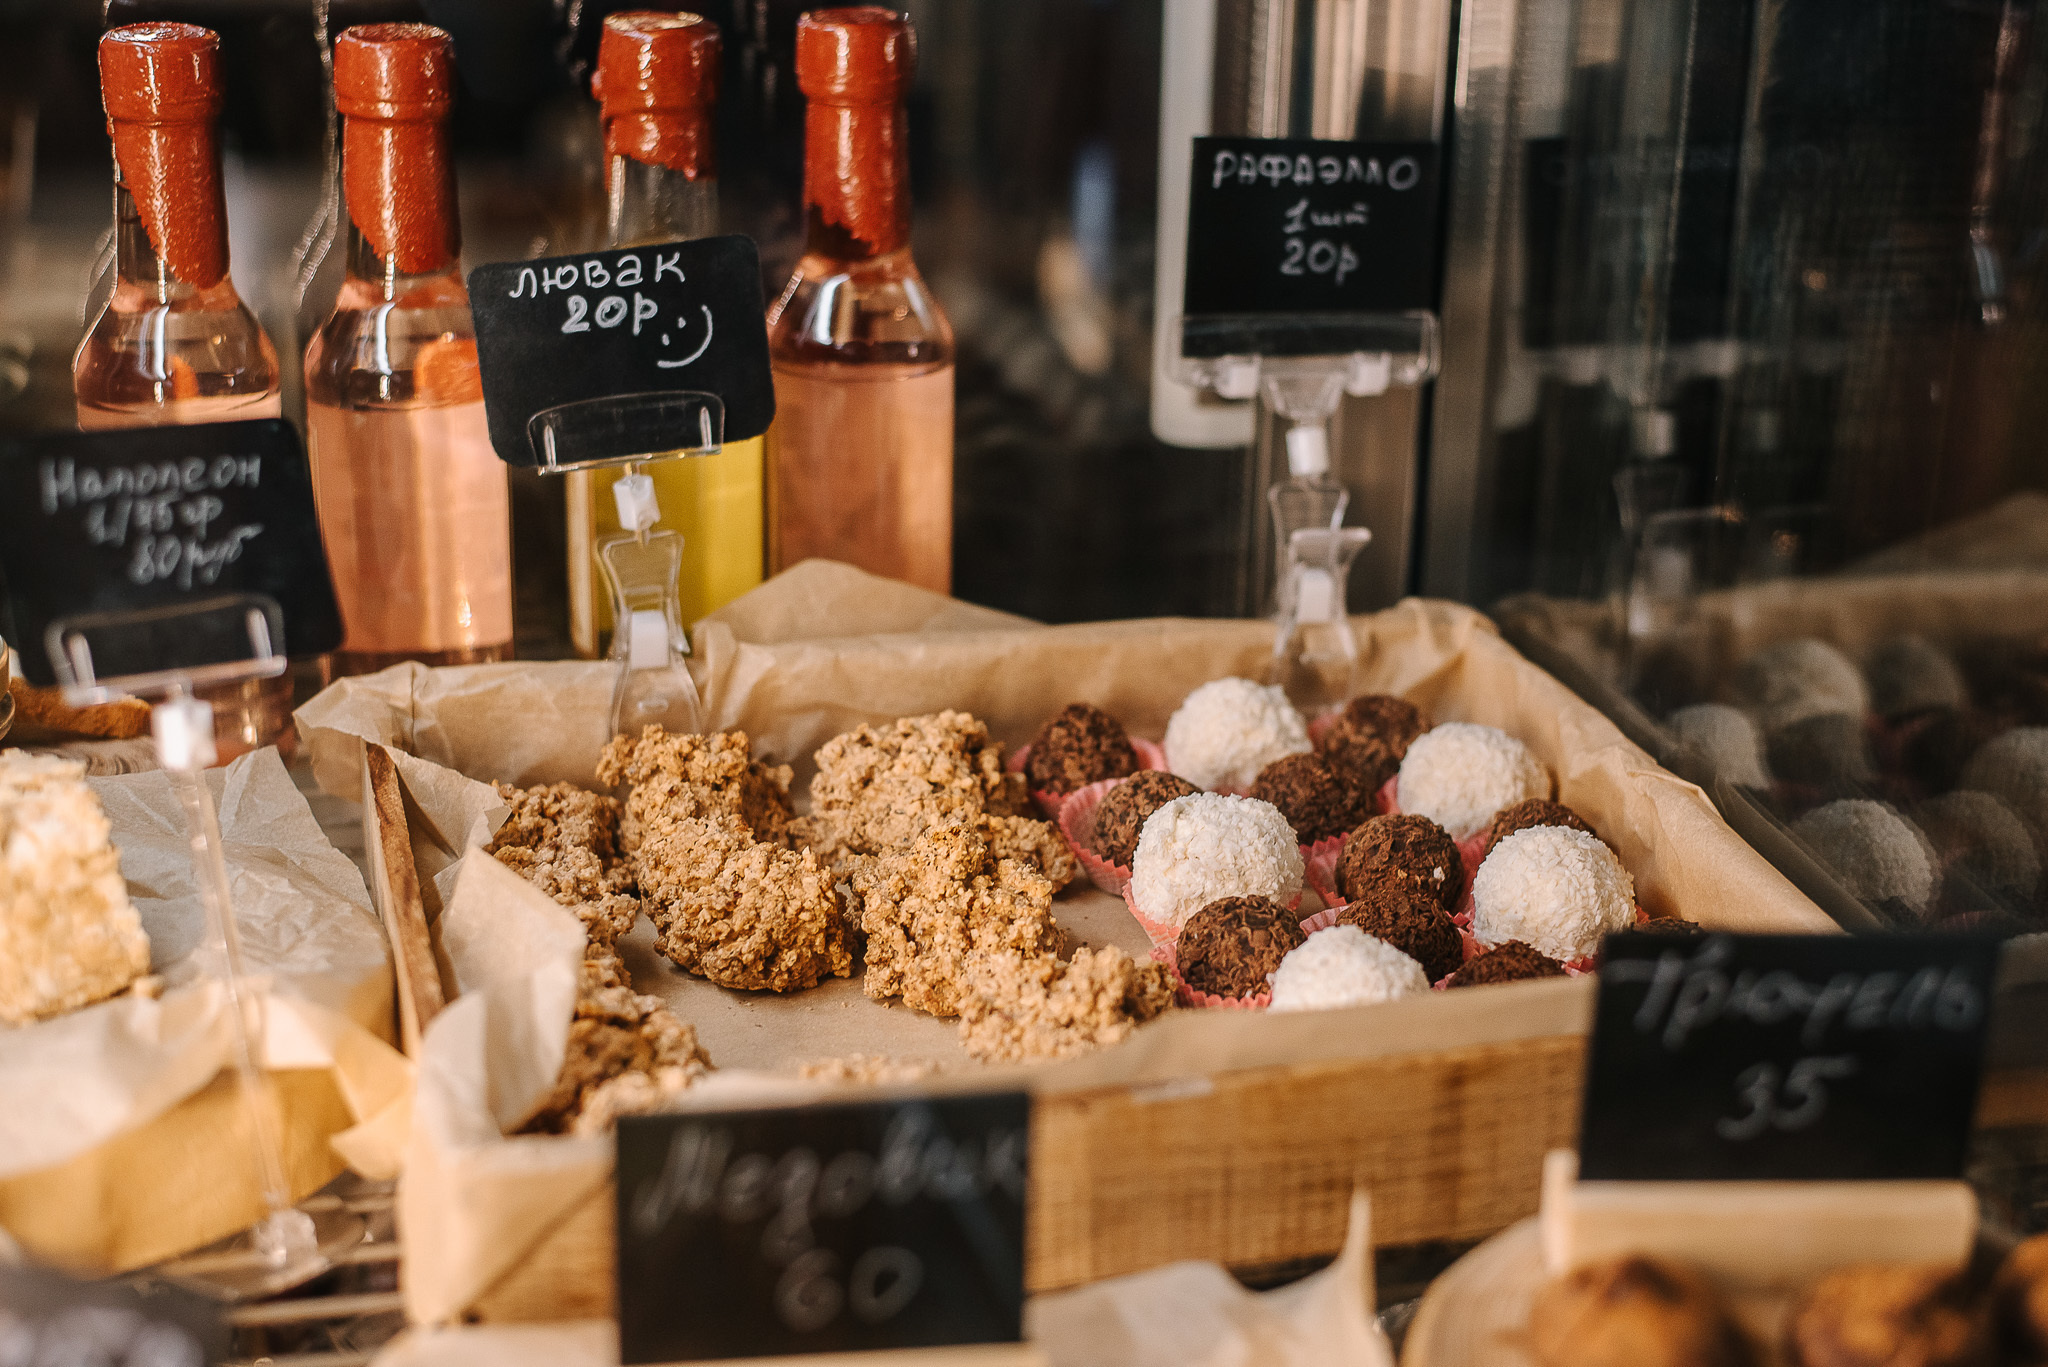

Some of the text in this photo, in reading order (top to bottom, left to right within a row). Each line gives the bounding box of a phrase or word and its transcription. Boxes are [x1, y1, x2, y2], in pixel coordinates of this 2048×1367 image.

[1279, 238, 1359, 287] 20р
[39, 453, 262, 515] Наполеон
[1604, 936, 1985, 1052] Трюфель
[1715, 1055, 1860, 1141] 35
[775, 1246, 926, 1334] 60
